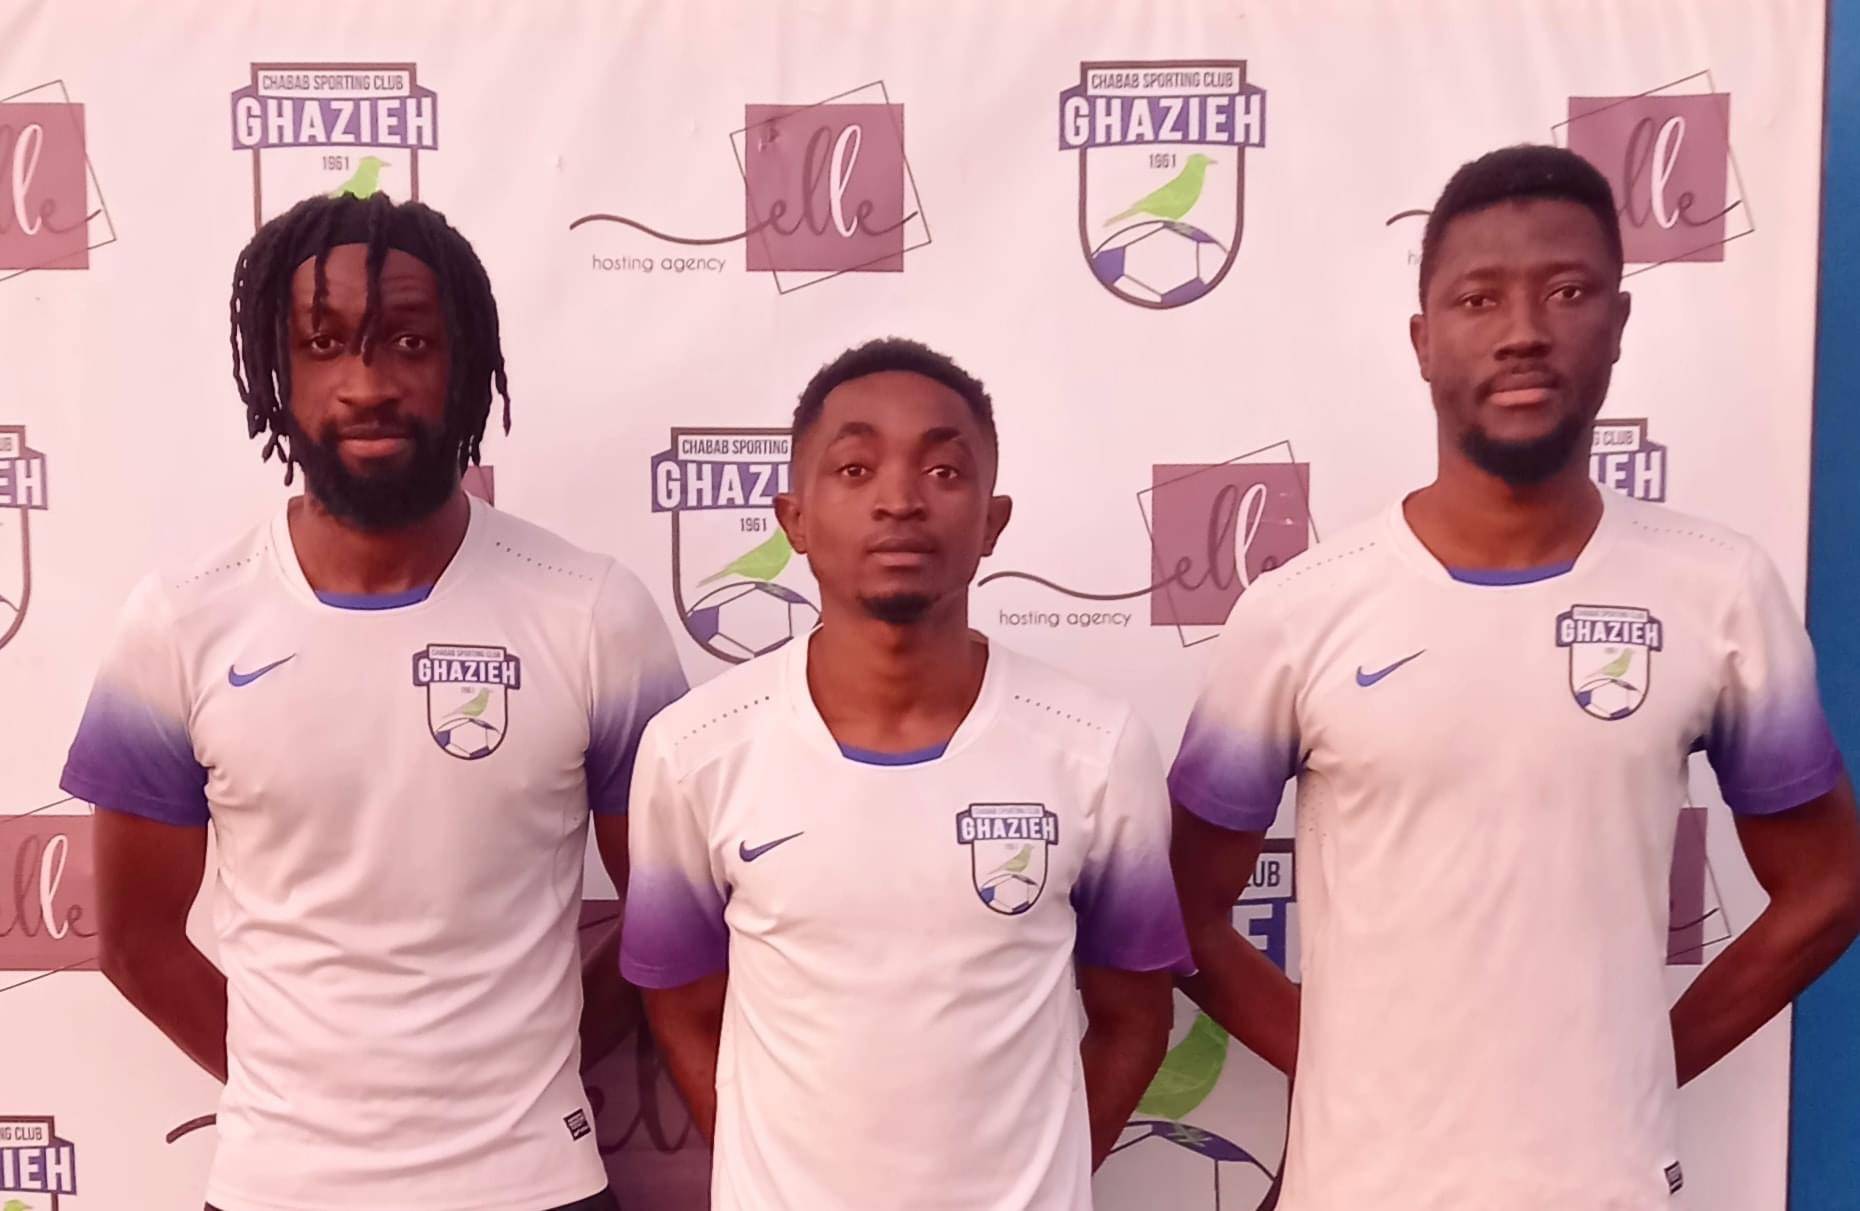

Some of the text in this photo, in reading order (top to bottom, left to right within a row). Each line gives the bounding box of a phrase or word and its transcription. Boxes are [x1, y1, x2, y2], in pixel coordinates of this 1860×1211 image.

[262, 74, 404, 91] CHABAB SPORTING CLUB
[1090, 70, 1234, 90] CHABAB SPORTING CLUB
[235, 96, 435, 146] GHAZIEH
[1063, 93, 1262, 147] GHAZIEH
[321, 155, 350, 171] 1961
[1149, 152, 1177, 169] 1961
[1618, 115, 1742, 229] lle
[758, 124, 918, 237] elle
[592, 253, 727, 274] hosting agency
[681, 438, 789, 455] CHABAB SPORTING
[656, 460, 790, 509] GHAZI
[739, 517, 768, 533] 1961
[999, 608, 1133, 628] hosting agency
[1561, 618, 1660, 647] GHAZIEH
[418, 658, 517, 685] GHAZIEH
[961, 816, 1056, 842] GHAZIEH
[0, 833, 99, 940] lle
[14, 1126, 43, 1141] CLUB
